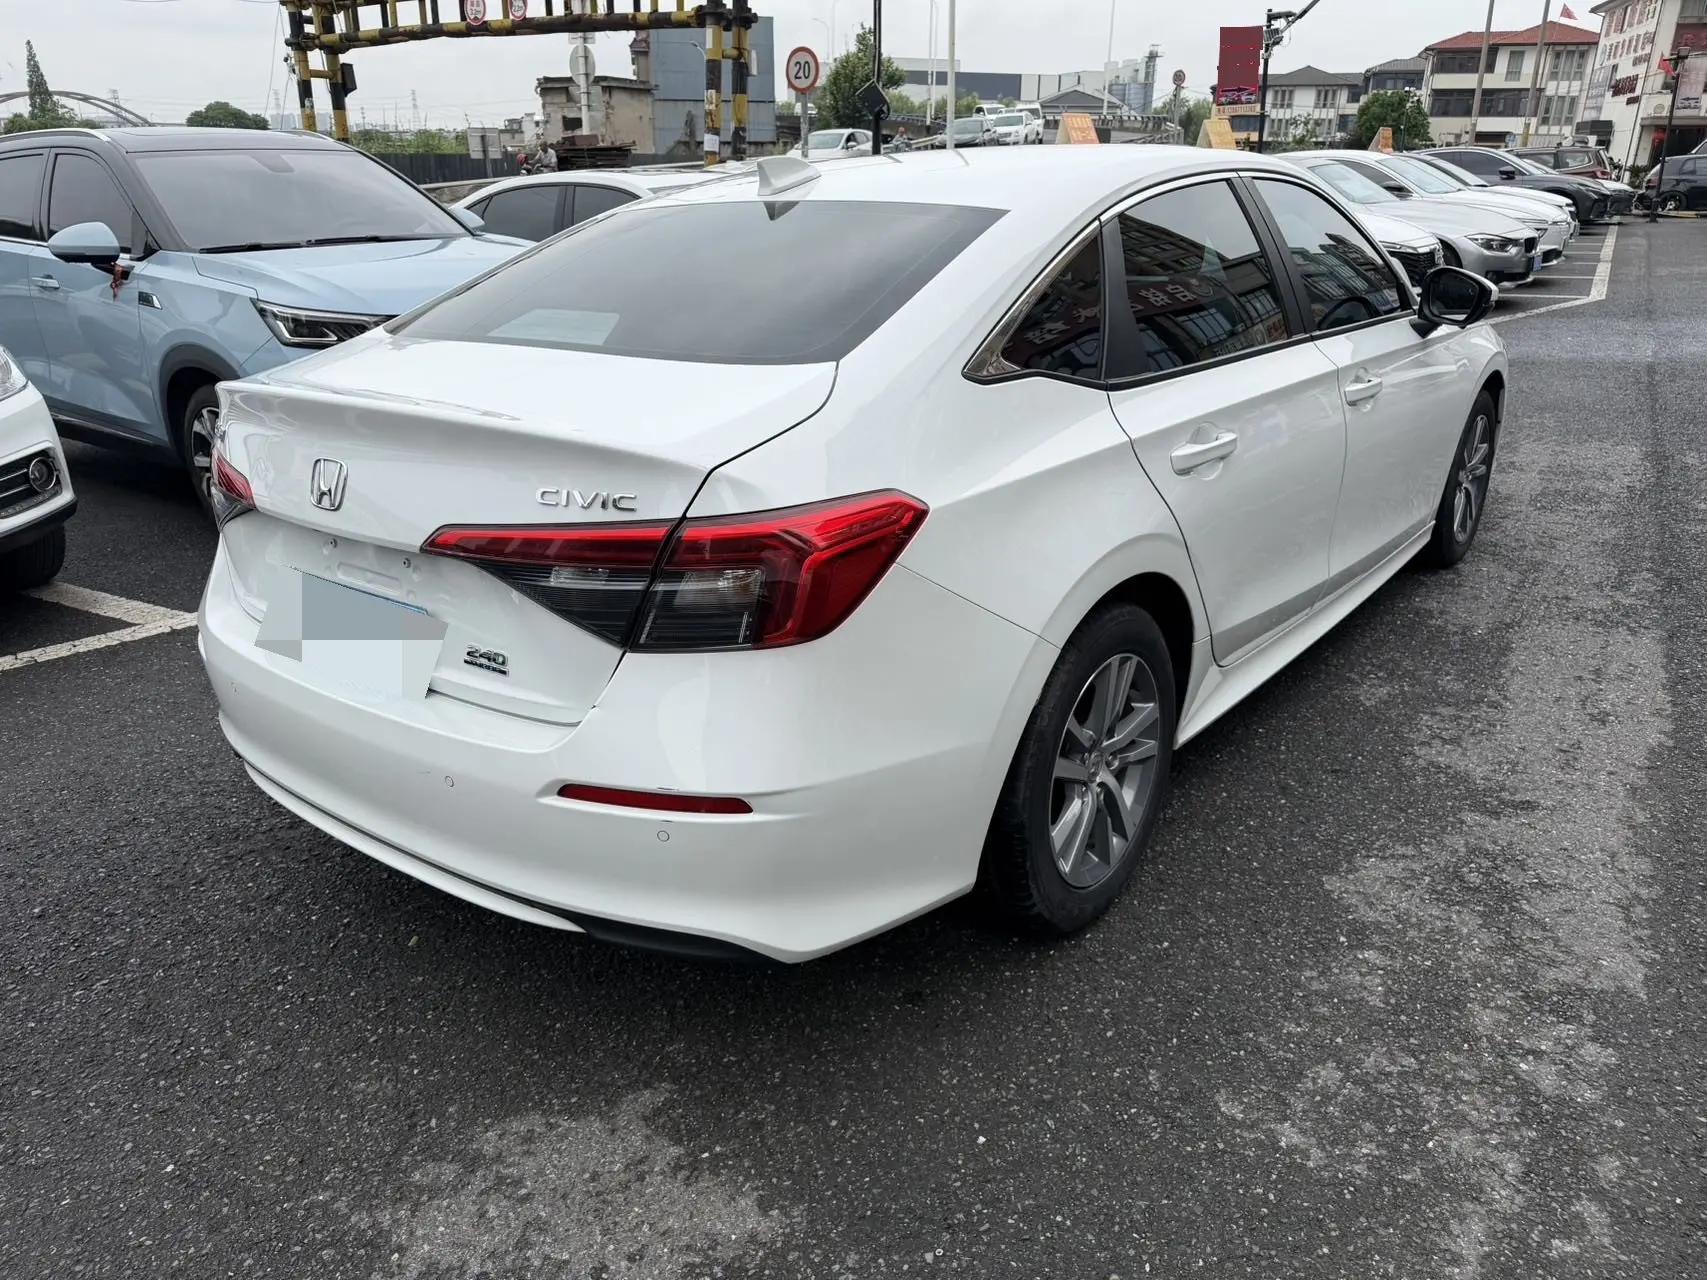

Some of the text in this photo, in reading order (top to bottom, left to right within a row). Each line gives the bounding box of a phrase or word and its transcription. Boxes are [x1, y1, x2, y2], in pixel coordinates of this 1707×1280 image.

[794, 60, 810, 79] 20
[536, 487, 637, 513] CIVIC
[465, 642, 508, 667] 240
